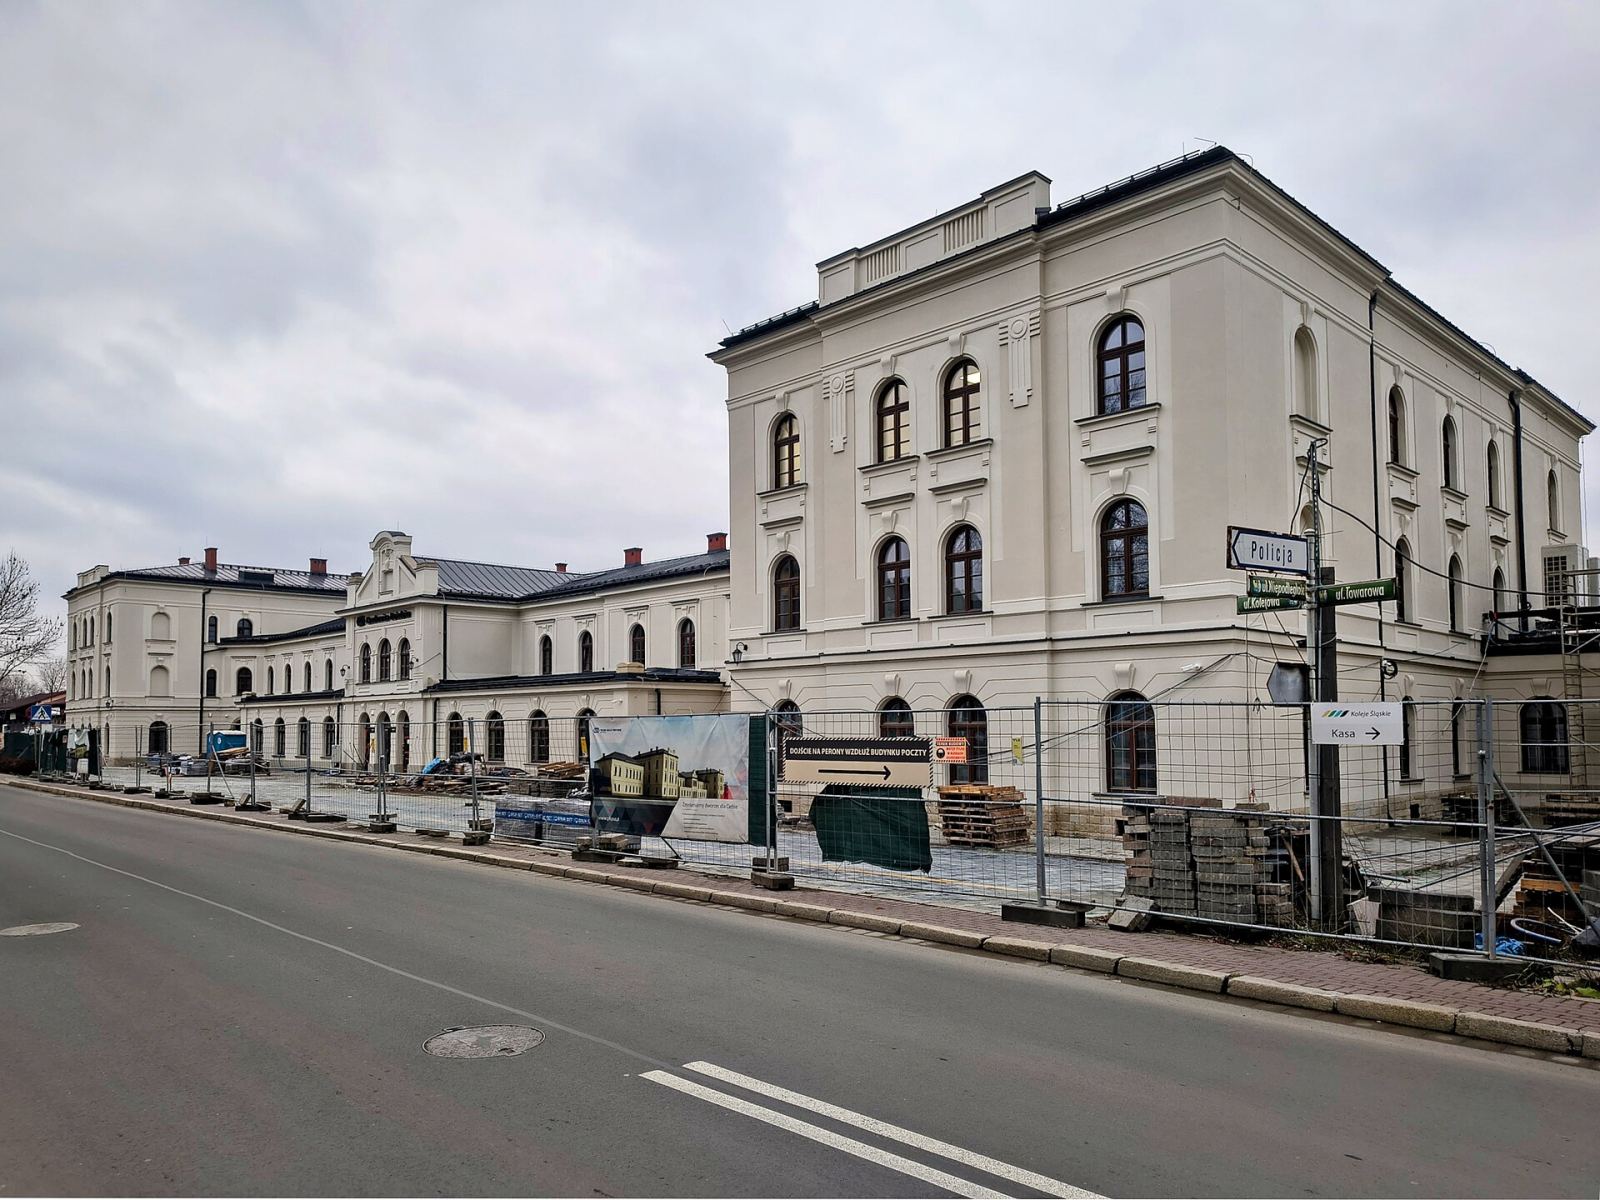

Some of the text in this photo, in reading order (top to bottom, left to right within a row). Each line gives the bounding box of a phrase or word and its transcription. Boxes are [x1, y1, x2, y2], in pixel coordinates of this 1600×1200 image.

[1251, 541, 1292, 567] Policja
[1335, 586, 1385, 600] ul.Towarowa
[1243, 597, 1280, 609] ul.Kolejowa
[1351, 709, 1391, 719] Koleje Śląskie
[1331, 729, 1355, 738] Kasa
[790, 747, 811, 755] DOJŚCIE
[845, 748, 870, 756] WZDŁUŻ
[870, 748, 900, 756] BUDYNKU
